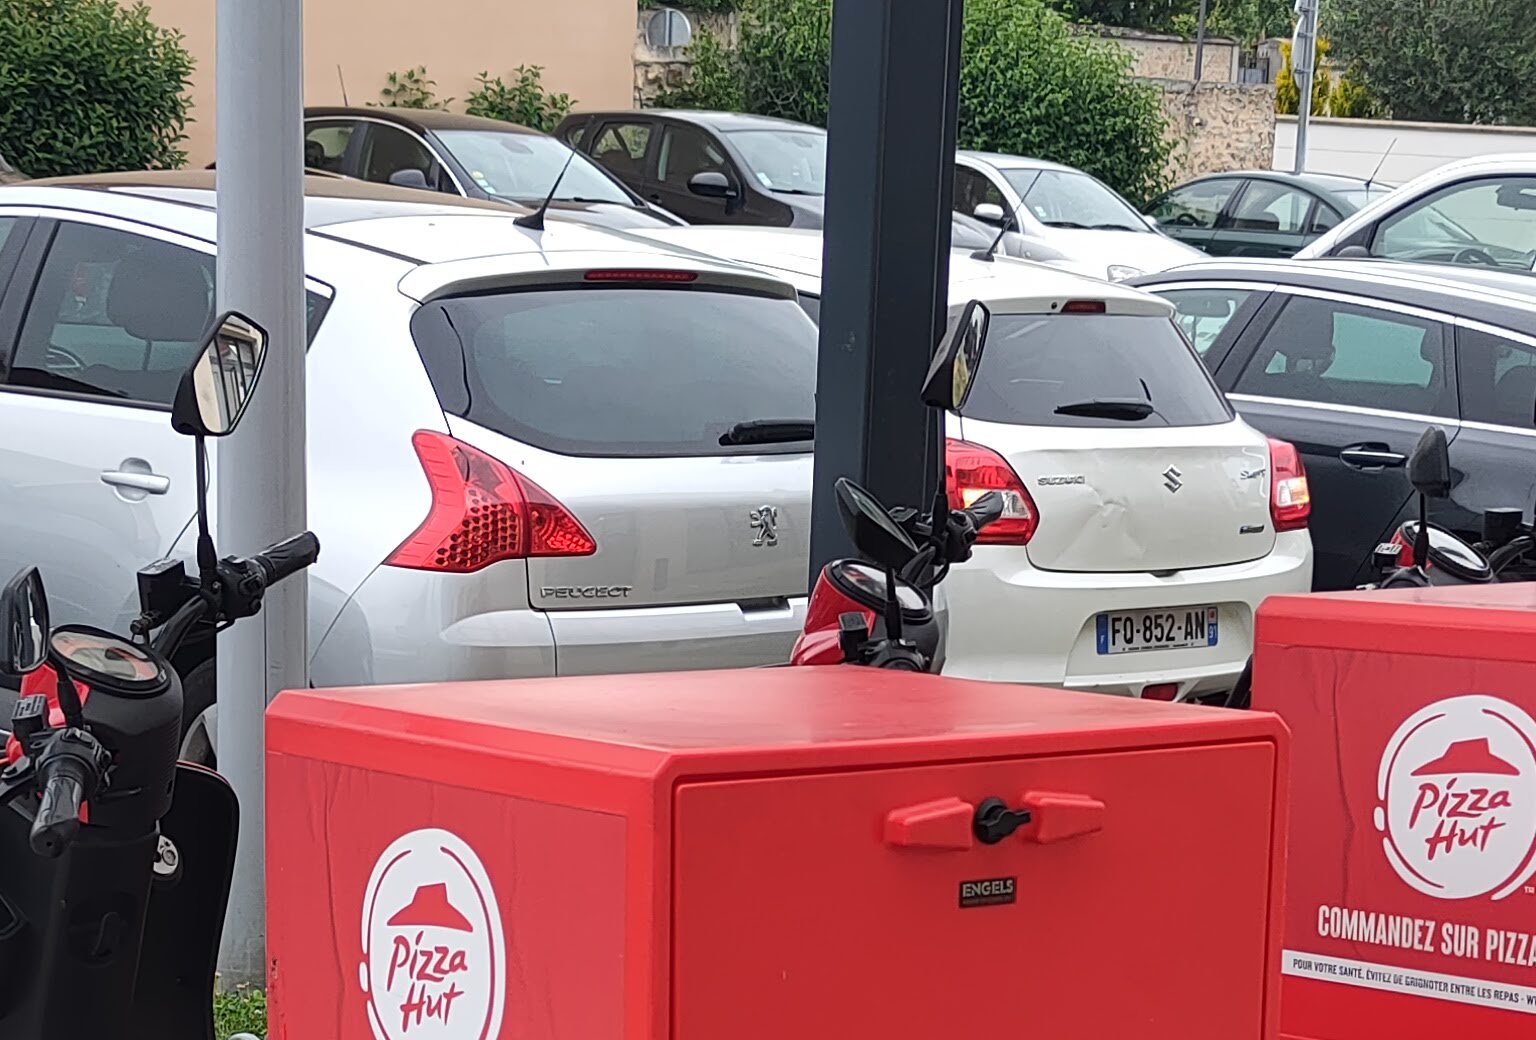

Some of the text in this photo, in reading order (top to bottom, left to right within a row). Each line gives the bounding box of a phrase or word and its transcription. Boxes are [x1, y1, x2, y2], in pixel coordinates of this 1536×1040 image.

[541, 586, 632, 599] PEUGEOT
[1111, 611, 1205, 646] FQ-852-AN
[1409, 777, 1512, 830] Pizza
[1425, 816, 1506, 861] Hut
[962, 879, 1013, 898] ENGELS
[1317, 904, 1436, 953] COMMANDEZ
[1441, 922, 1479, 959] SUR
[387, 930, 468, 992] Pizza
[1293, 958, 1312, 971] POUR
[1314, 962, 1337, 975] VOTRE
[1366, 968, 1391, 983] ÉVITEZ
[1393, 974, 1403, 985] DE
[1405, 975, 1448, 993] GRIGNOTER
[1450, 983, 1475, 997] ENTRE
[1477, 987, 1491, 999] LES
[1493, 989, 1519, 1003] REPAS
[399, 981, 464, 1033] Hut
